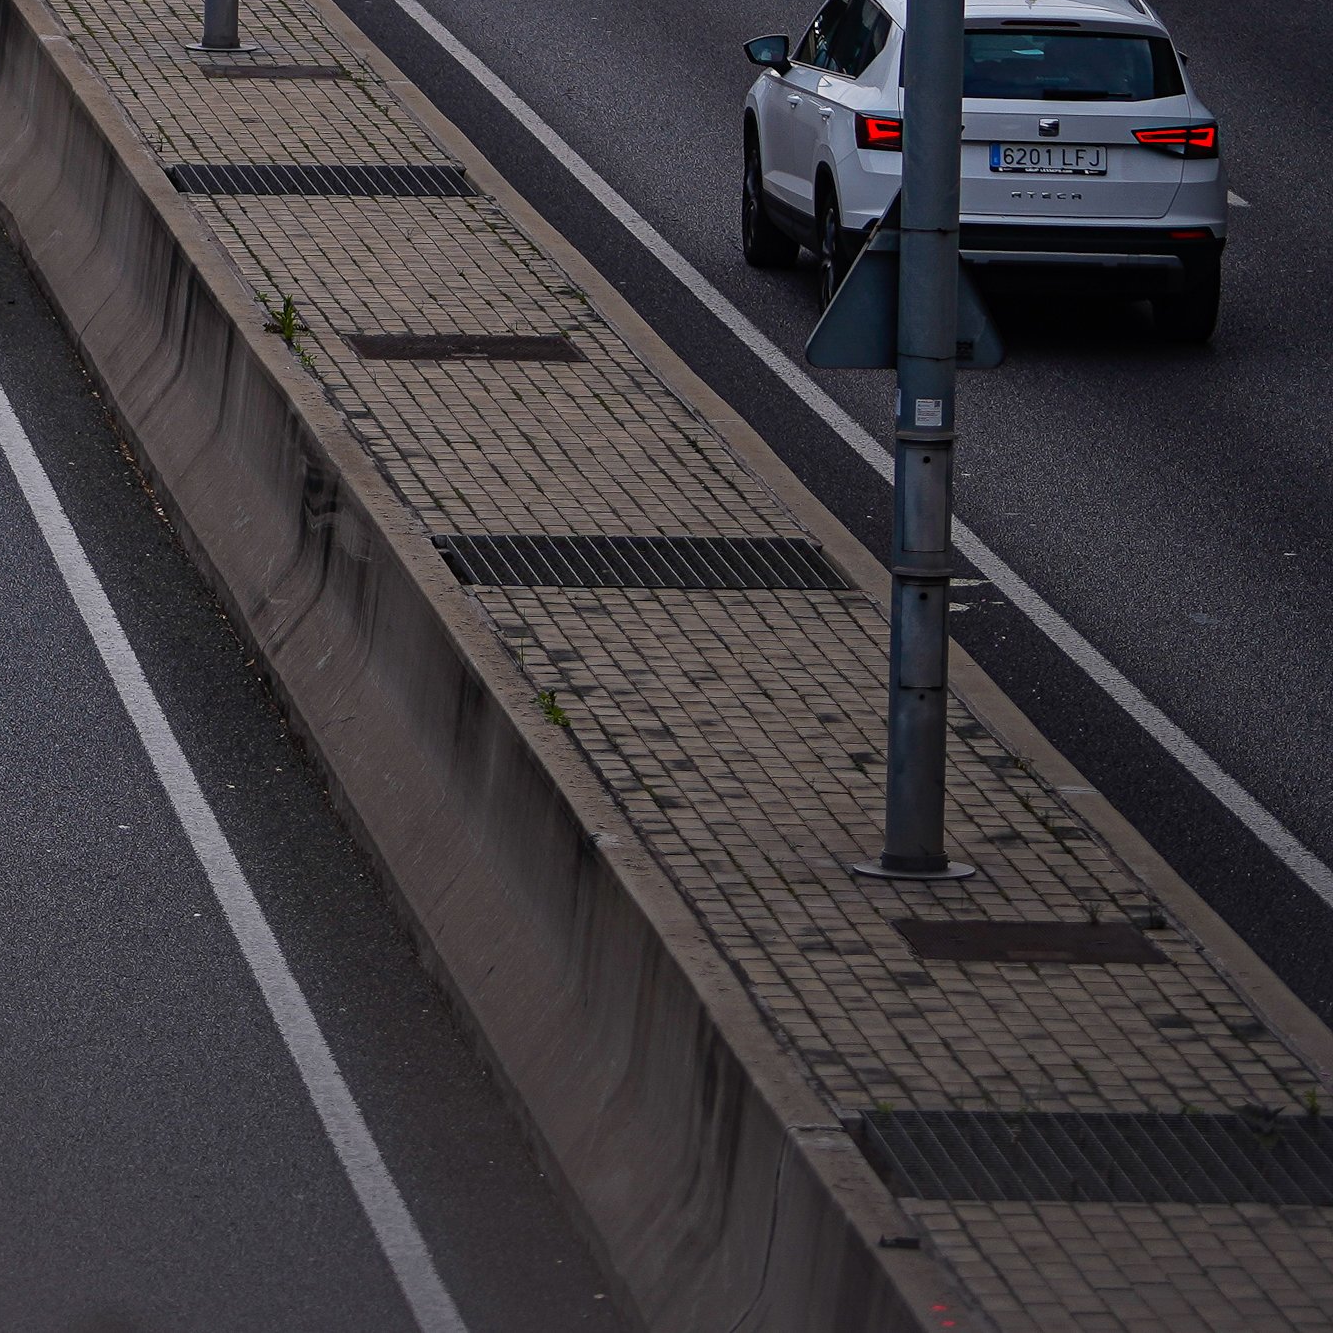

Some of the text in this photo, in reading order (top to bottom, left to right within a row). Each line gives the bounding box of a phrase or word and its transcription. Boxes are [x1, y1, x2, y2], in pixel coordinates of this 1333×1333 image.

[1003, 147, 1100, 167] 6201 LFJ
[1011, 191, 1083, 200] ATECA
